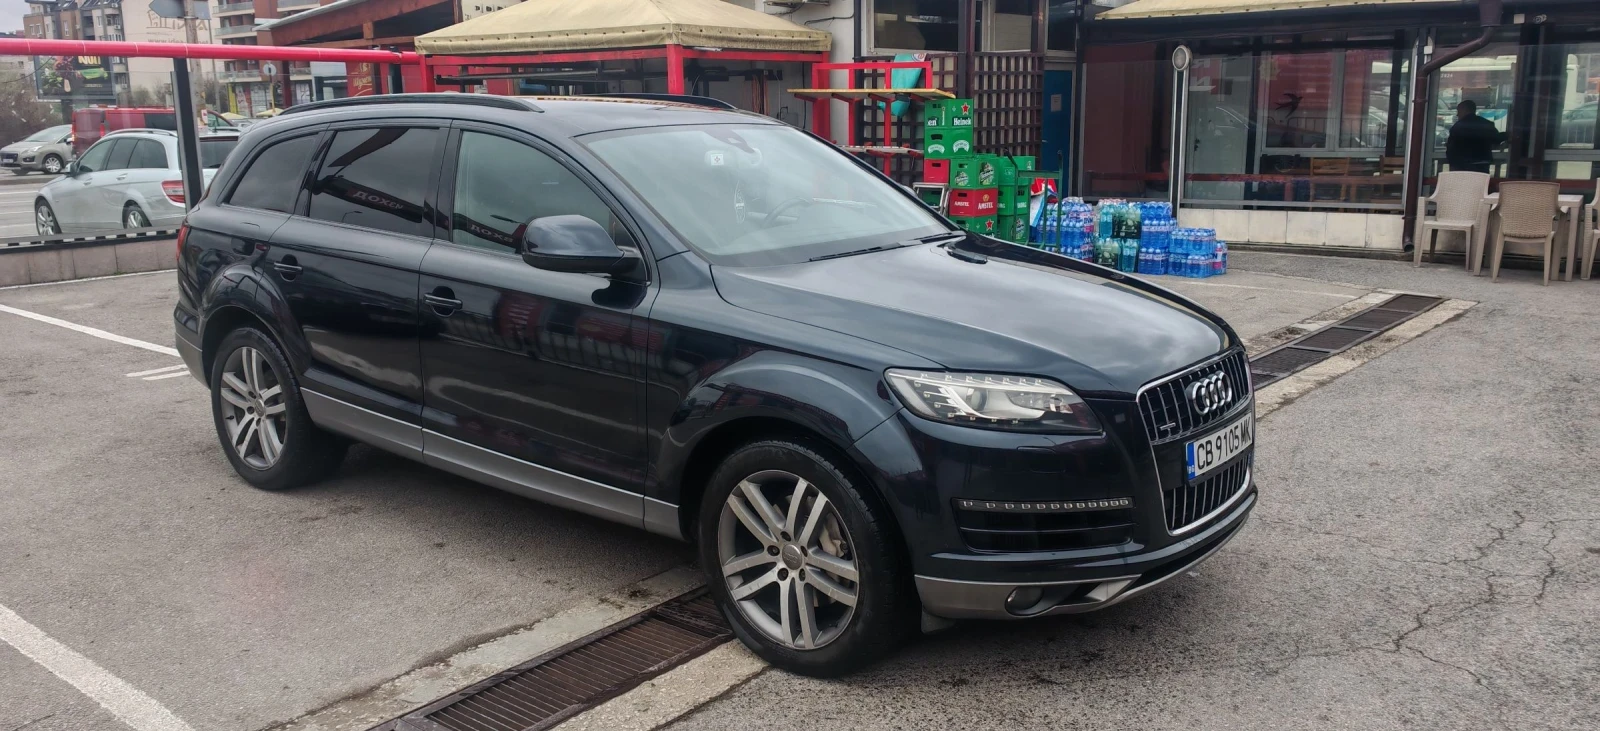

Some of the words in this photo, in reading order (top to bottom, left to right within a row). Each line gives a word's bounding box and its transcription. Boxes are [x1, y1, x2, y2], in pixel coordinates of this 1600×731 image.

[977, 201, 994, 210] AMSTEL
[1197, 440, 1214, 470] CB
[1215, 424, 1240, 461] 9105
[1240, 416, 1252, 446] MK
